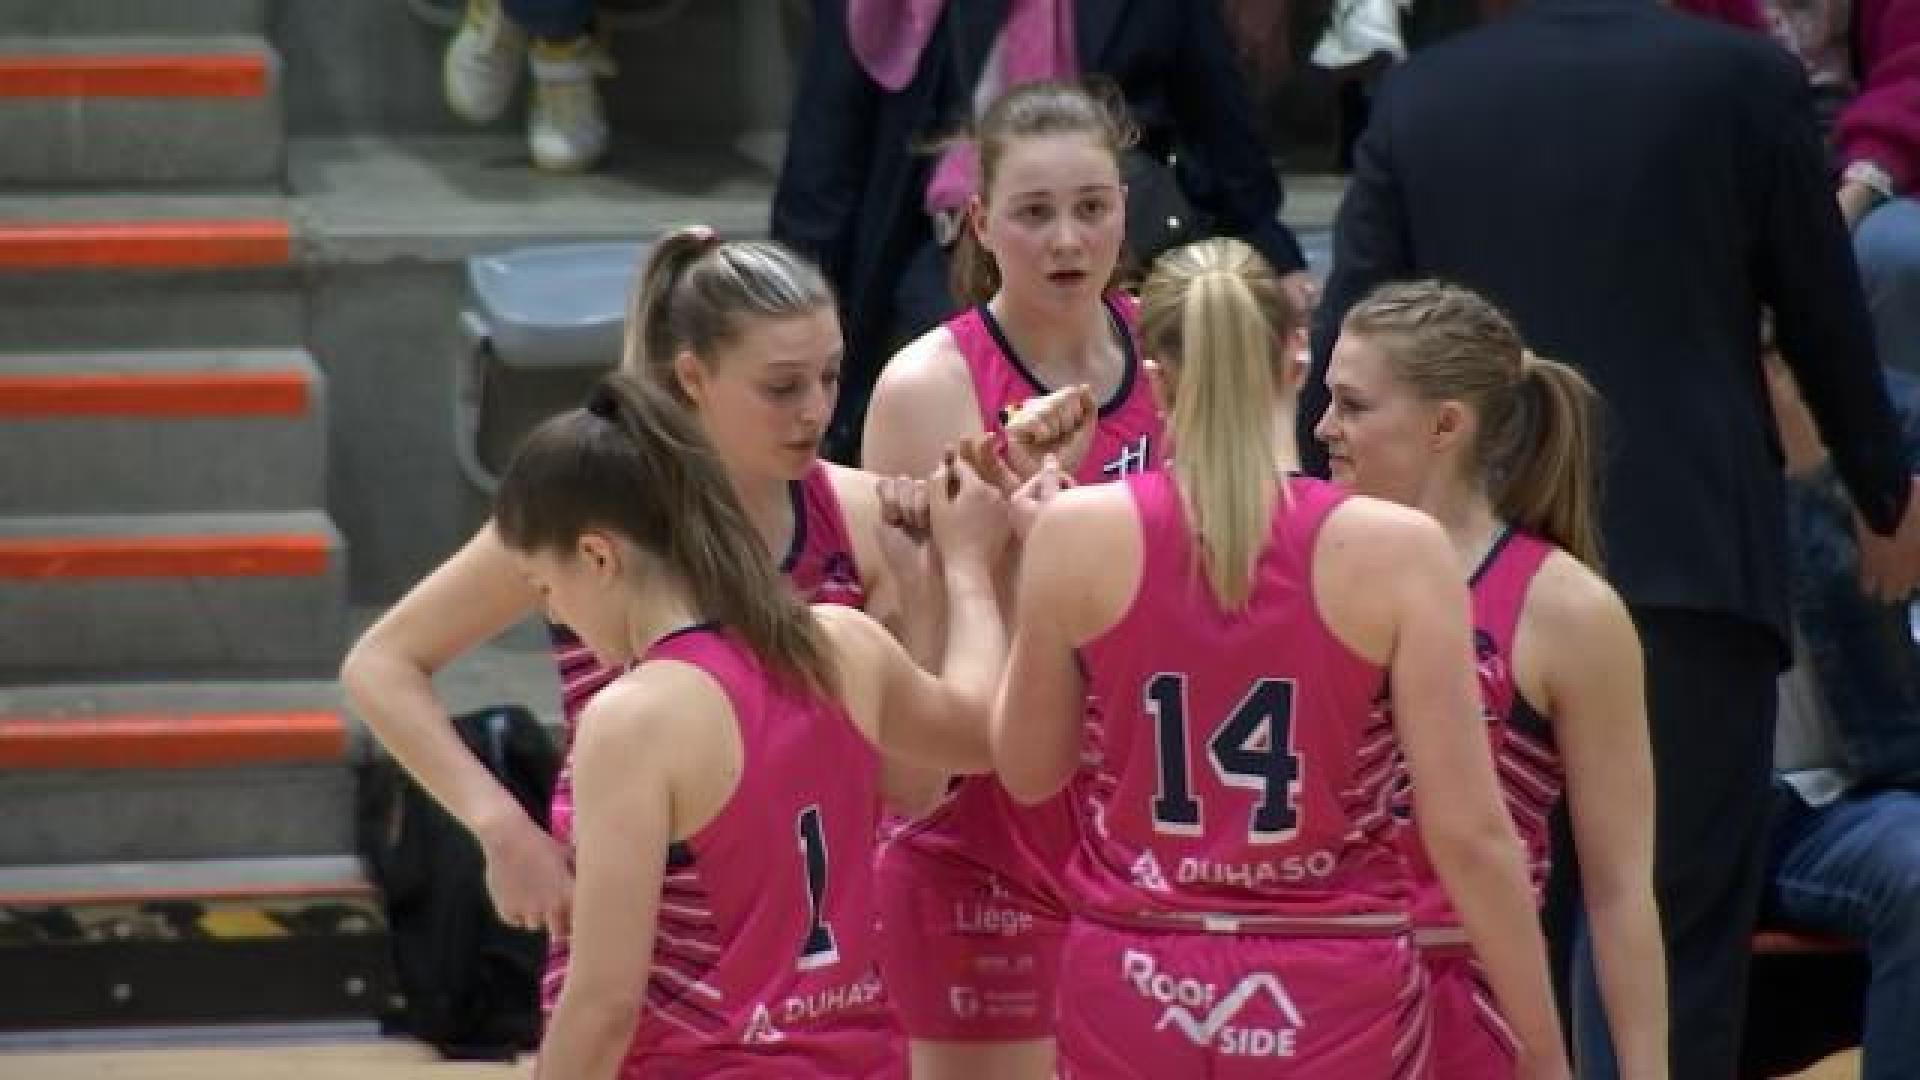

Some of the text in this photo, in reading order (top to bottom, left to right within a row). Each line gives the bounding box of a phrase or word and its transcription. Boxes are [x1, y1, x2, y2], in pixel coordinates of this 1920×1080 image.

[1145, 672, 1304, 844] 14
[796, 803, 840, 970] 1
[1178, 850, 1336, 887] DUHASO
[1219, 1028, 1298, 1057] SIDE
